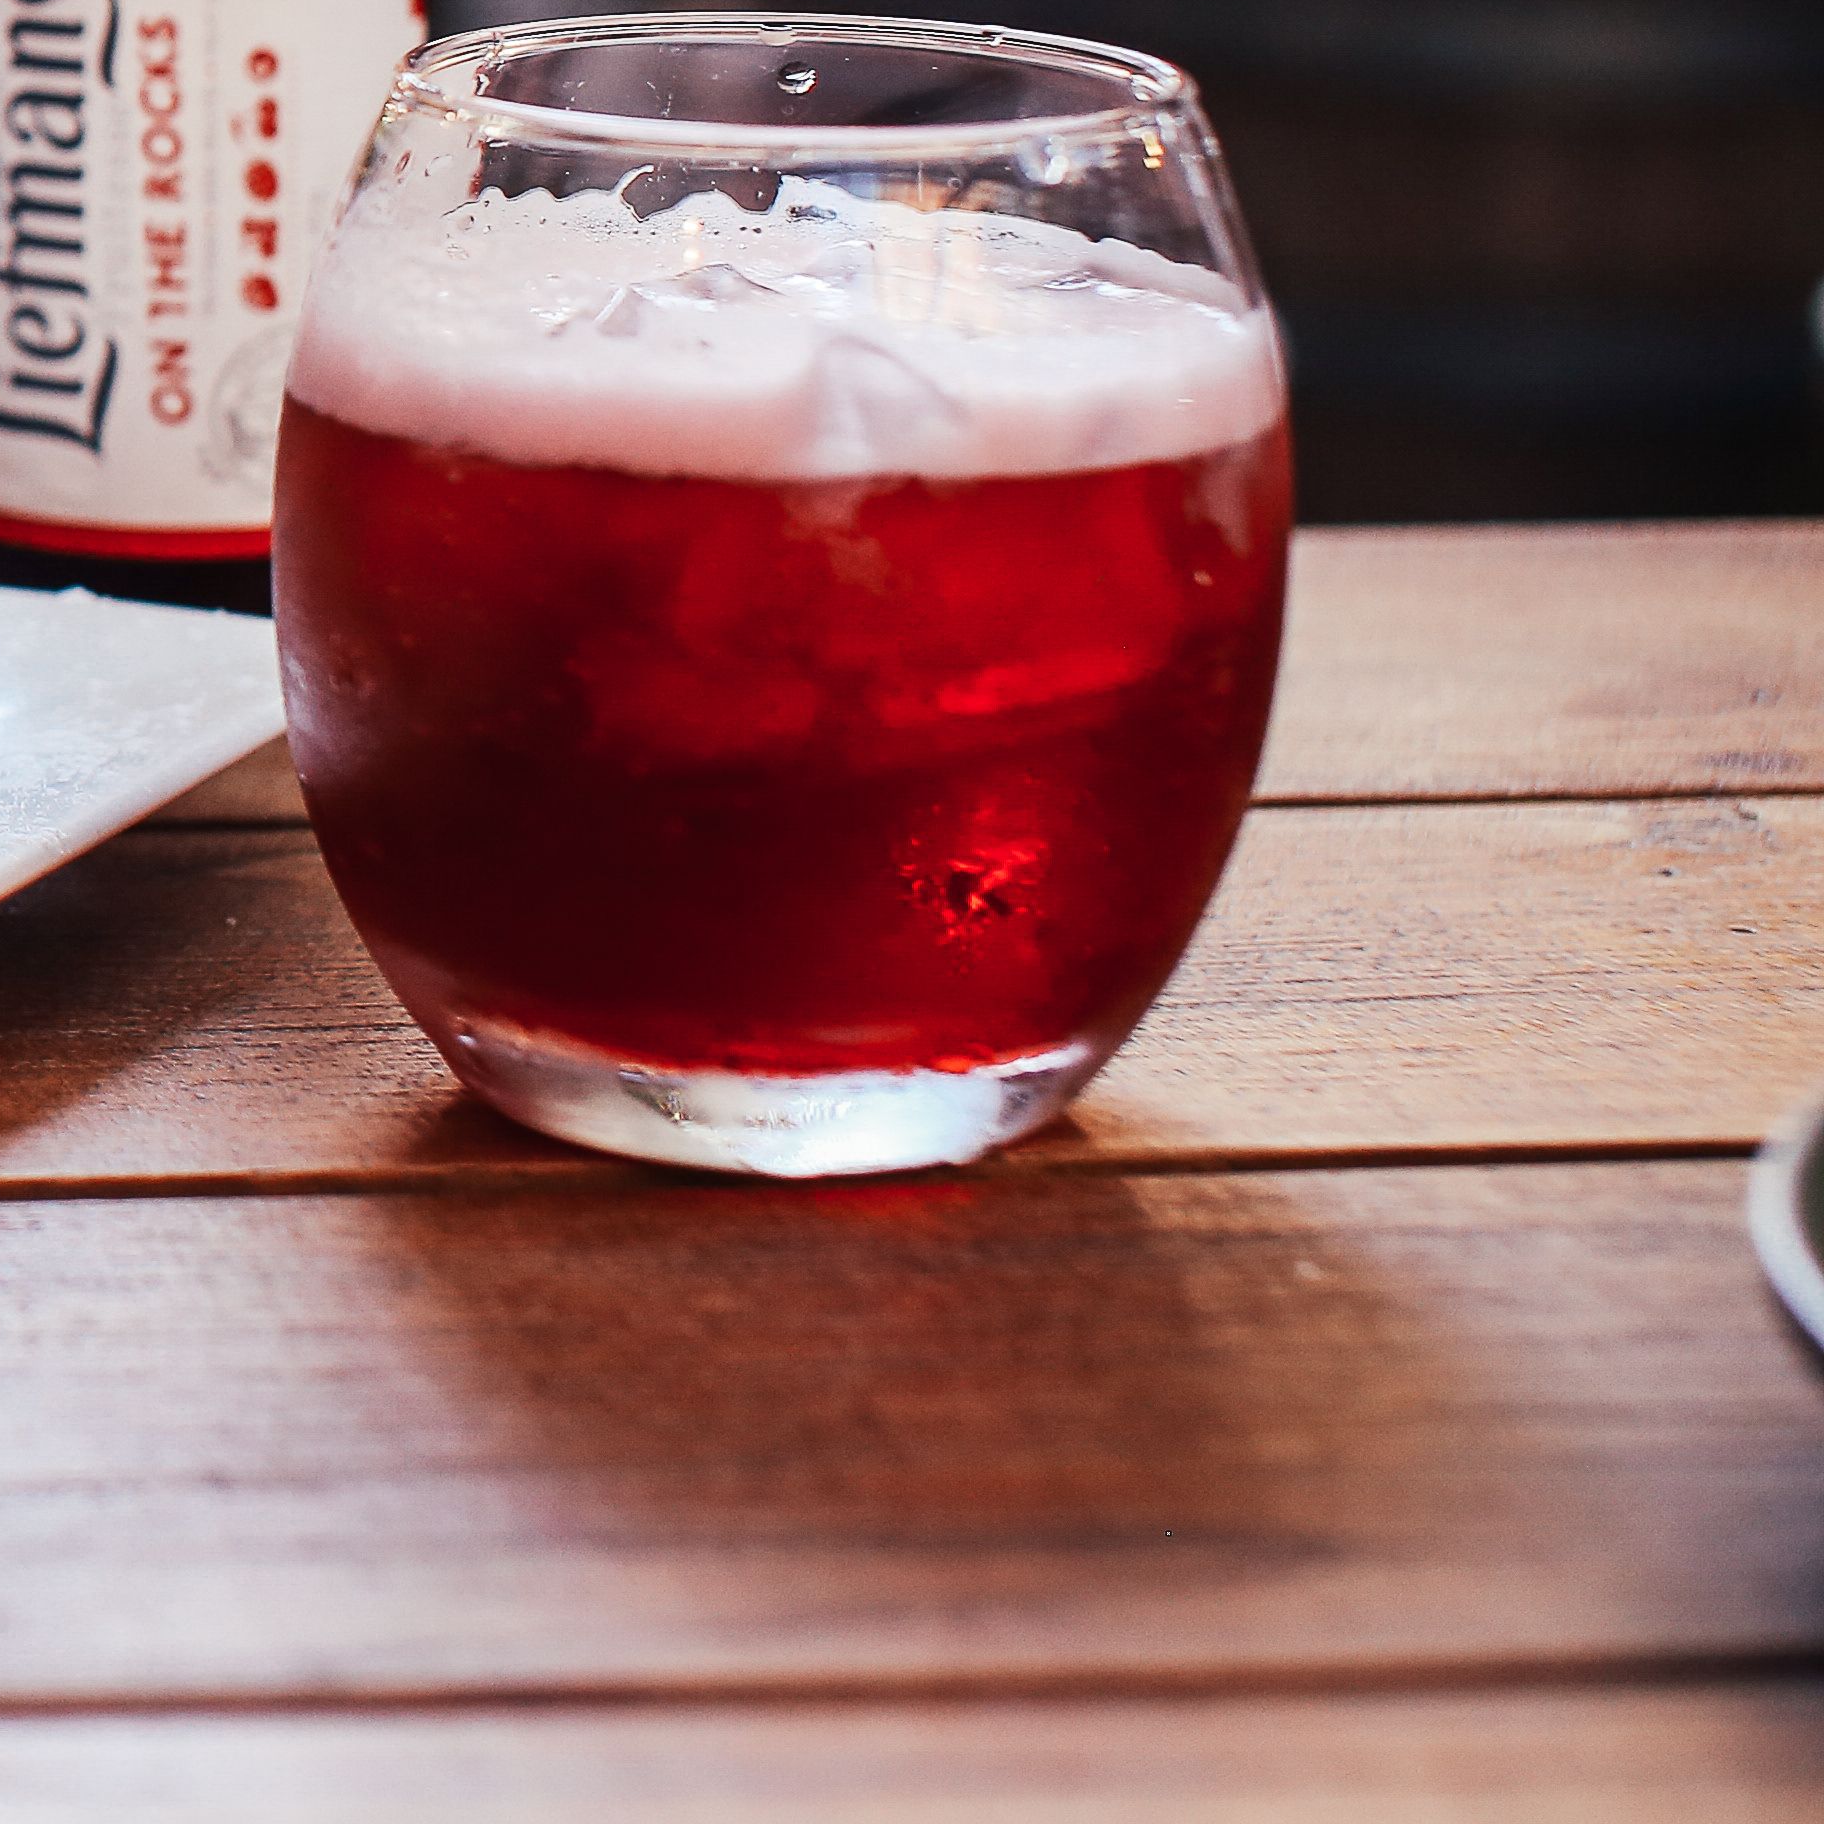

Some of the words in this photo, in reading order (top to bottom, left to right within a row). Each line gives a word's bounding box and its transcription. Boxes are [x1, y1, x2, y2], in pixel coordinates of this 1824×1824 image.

[138, 17, 183, 202] ROCKS
[145, 224, 187, 318] THE
[150, 337, 195, 426] ON
